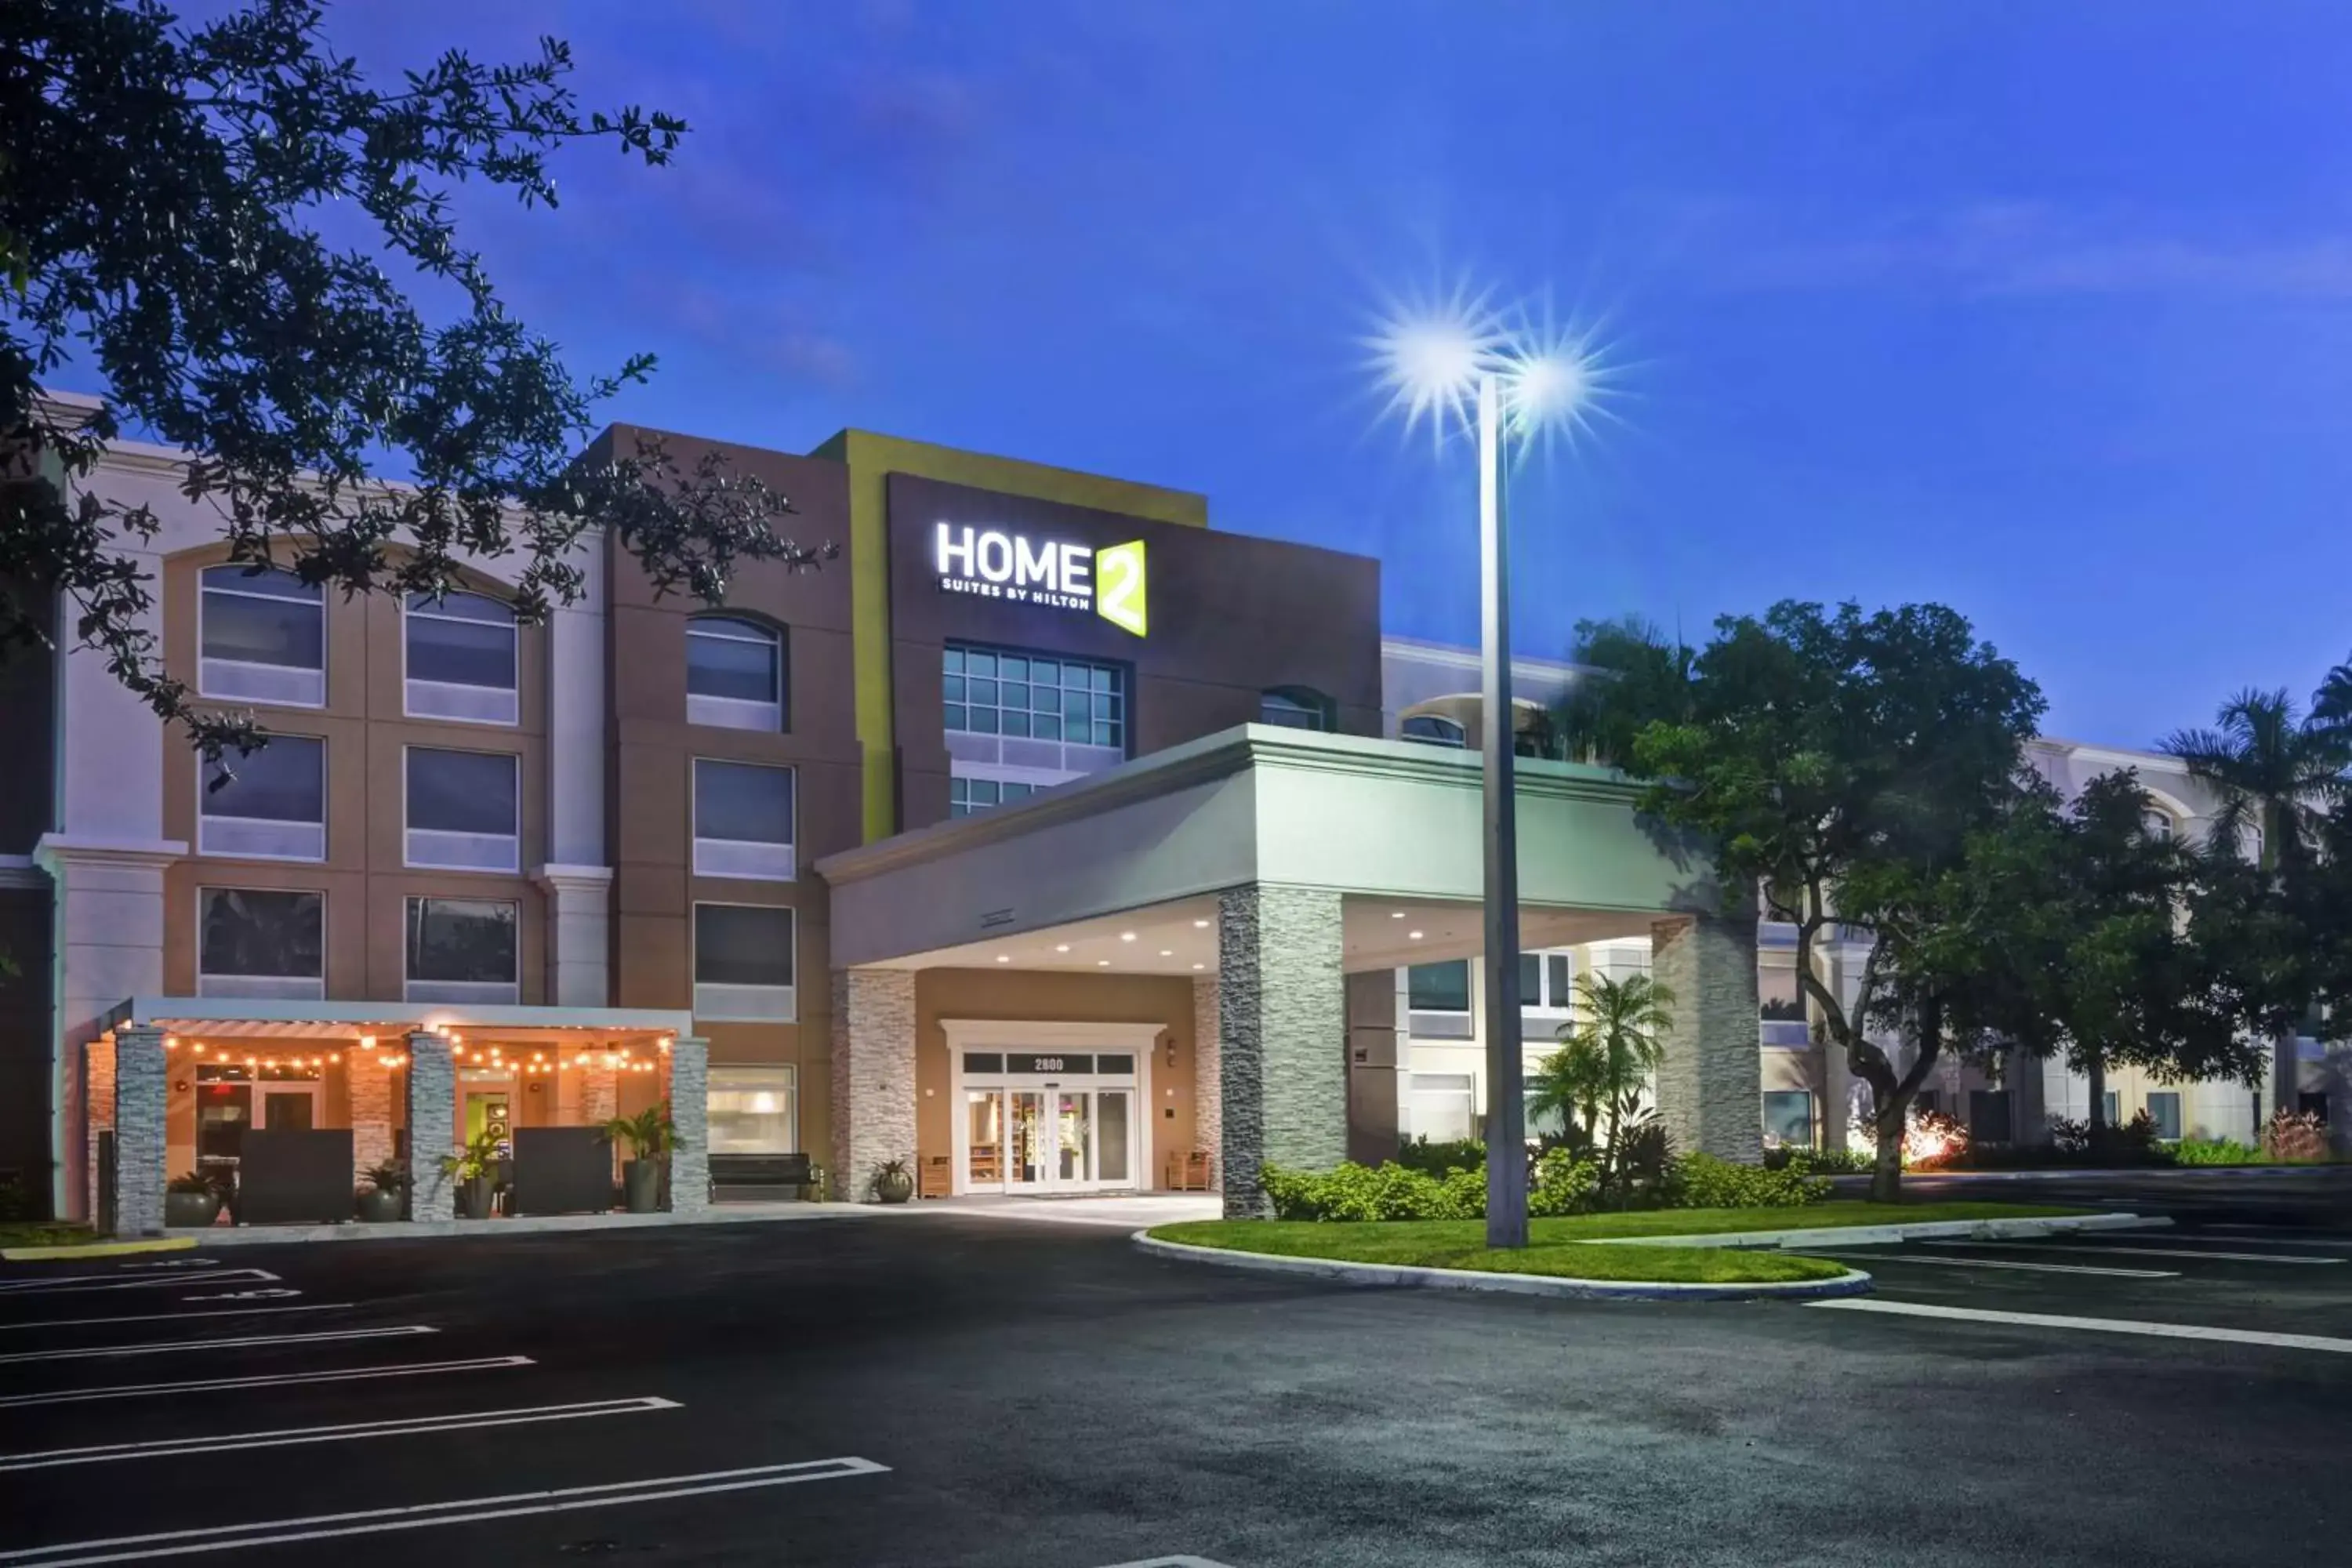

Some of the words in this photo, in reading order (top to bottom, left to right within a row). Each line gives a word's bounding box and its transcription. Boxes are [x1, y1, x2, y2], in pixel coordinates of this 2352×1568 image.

[938, 523, 1092, 596] HOME
[1102, 549, 1141, 630] 2
[943, 578, 1000, 597] SUITES
[1007, 587, 1026, 601] BY
[1033, 592, 1089, 610] HILTON
[1035, 1058, 1064, 1071] 2800
